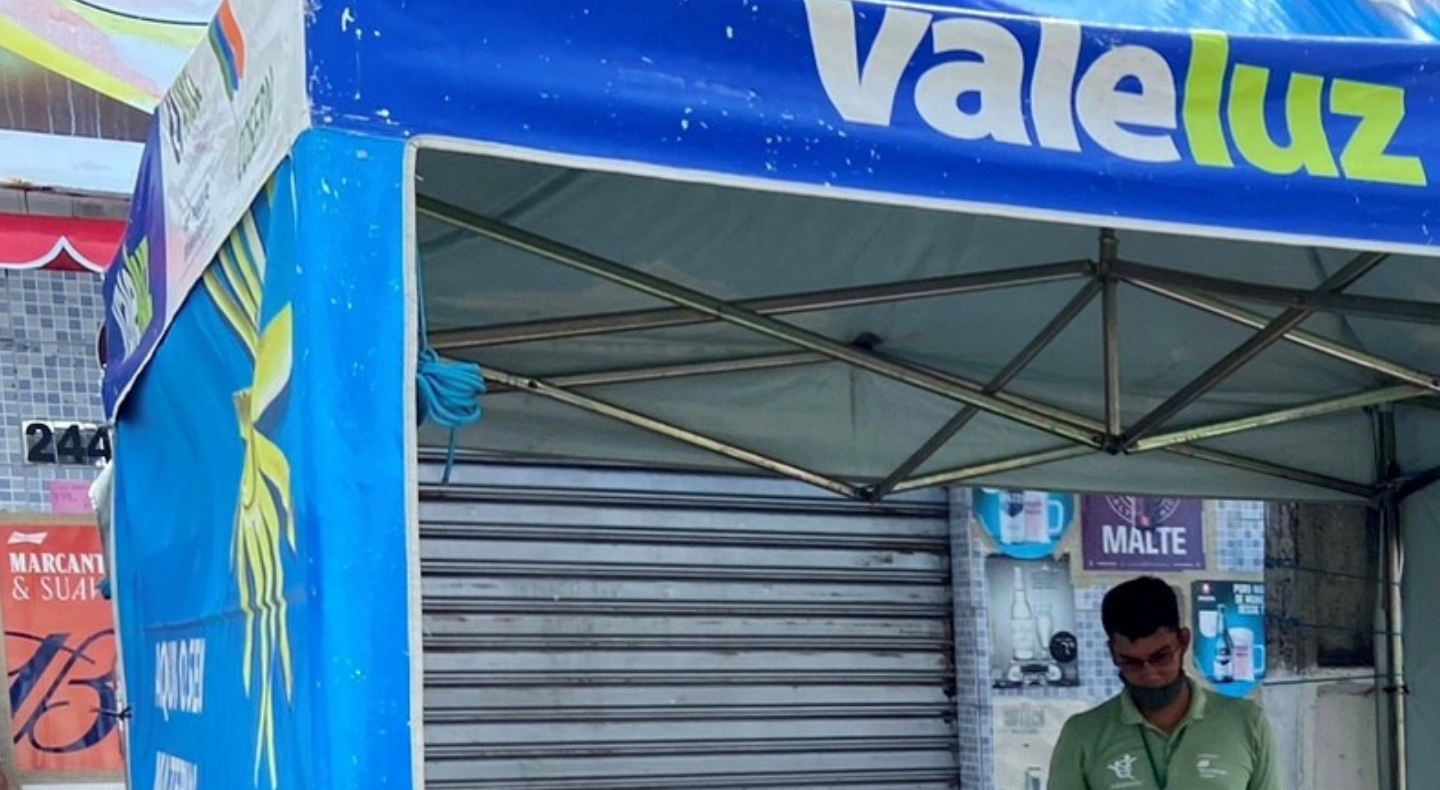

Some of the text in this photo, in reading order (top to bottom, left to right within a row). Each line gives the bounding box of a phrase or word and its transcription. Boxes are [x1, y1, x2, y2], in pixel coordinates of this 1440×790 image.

[26, 423, 111, 464] 244
[1102, 525, 1187, 555] MALTE
[12, 575, 30, 601] &
